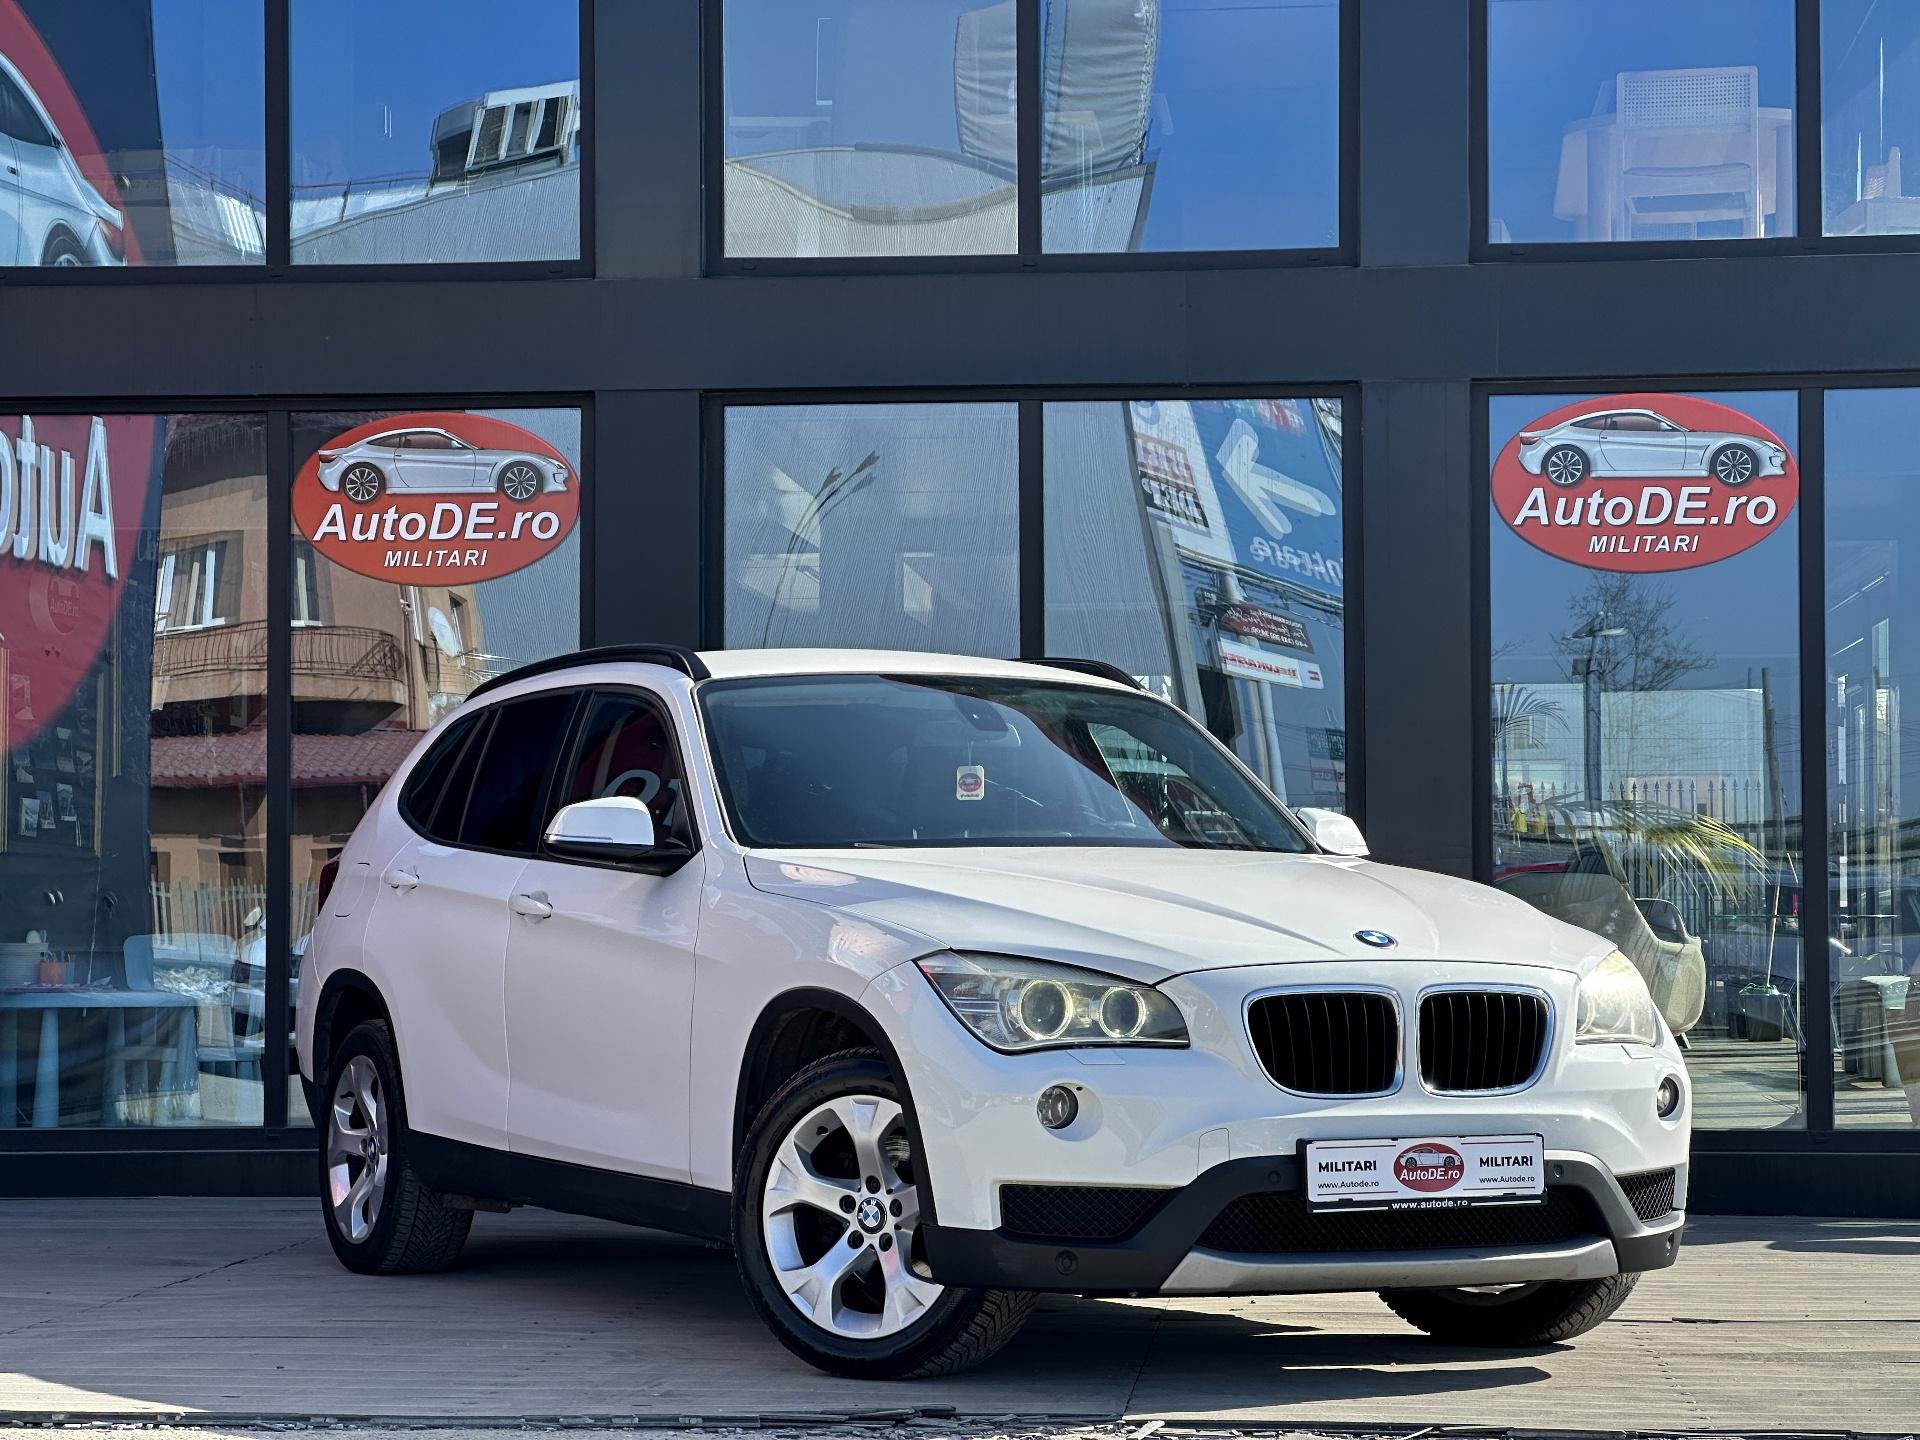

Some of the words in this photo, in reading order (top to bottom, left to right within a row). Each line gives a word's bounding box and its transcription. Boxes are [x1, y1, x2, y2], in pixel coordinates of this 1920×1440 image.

[1513, 486, 1778, 526] AutoDE.ro
[312, 502, 560, 542] AutoDE.ro
[1588, 534, 1700, 553] MILITARI
[383, 548, 488, 568] MILITARI
[1318, 1160, 1377, 1173] MILITARI
[1479, 1155, 1533, 1168] MILITARI
[1399, 1167, 1460, 1181] AutoDE.ro
[1479, 1175, 1535, 1184] www.Autode.ro
[1318, 1180, 1380, 1189] www.Autode.ro
[1392, 1198, 1468, 1209] www.autode.ro
